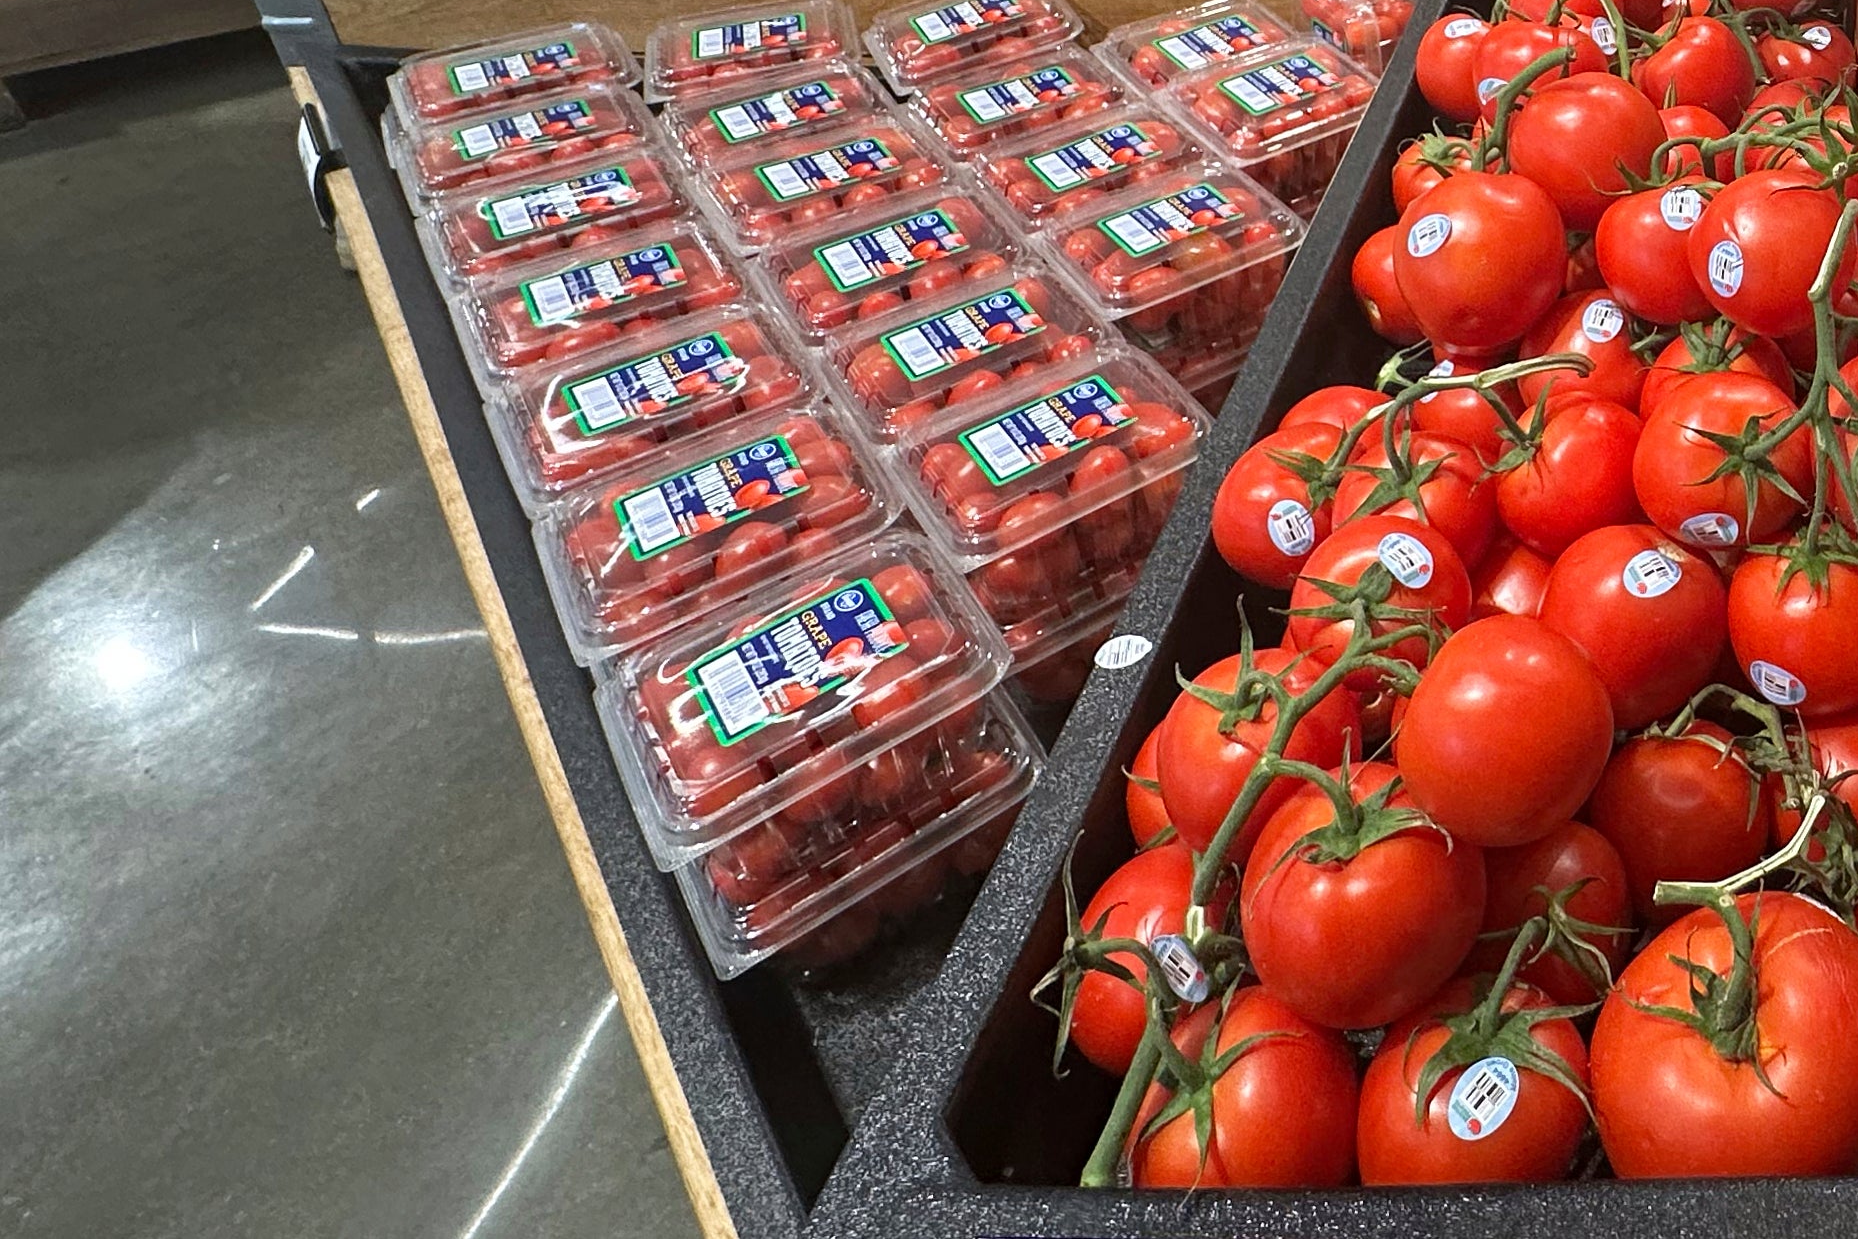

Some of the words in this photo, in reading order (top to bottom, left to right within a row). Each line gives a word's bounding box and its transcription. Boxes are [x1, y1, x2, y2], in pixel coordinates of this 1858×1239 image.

[1047, 397, 1077, 424] GRAPE
[801, 610, 833, 650] GRAPE
[770, 617, 829, 689] TOMATOES
